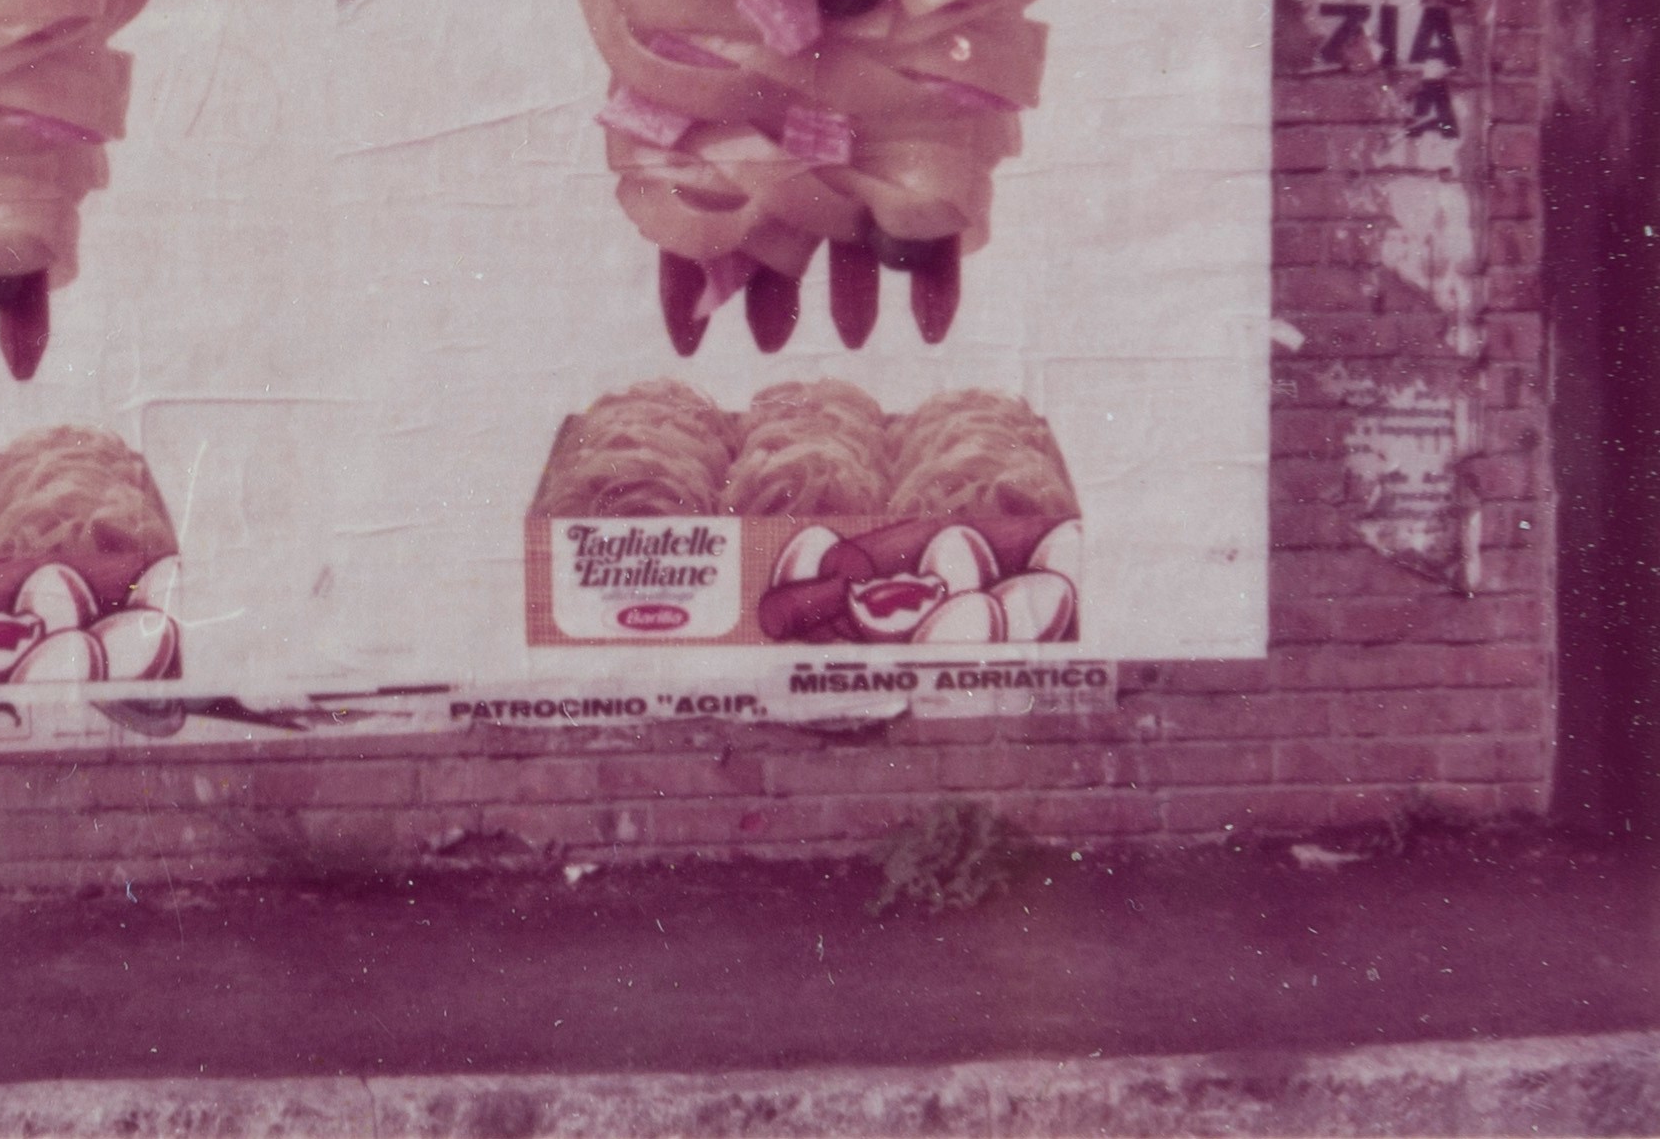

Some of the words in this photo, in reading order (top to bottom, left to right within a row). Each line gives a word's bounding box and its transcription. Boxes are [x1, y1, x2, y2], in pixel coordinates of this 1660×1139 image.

[567, 525, 726, 562] Tagliatelle
[574, 560, 718, 587] Emiliane
[789, 670, 919, 694] MISANO
[934, 667, 1108, 690] ADRIATICO
[450, 698, 648, 721] PATROCINIO
